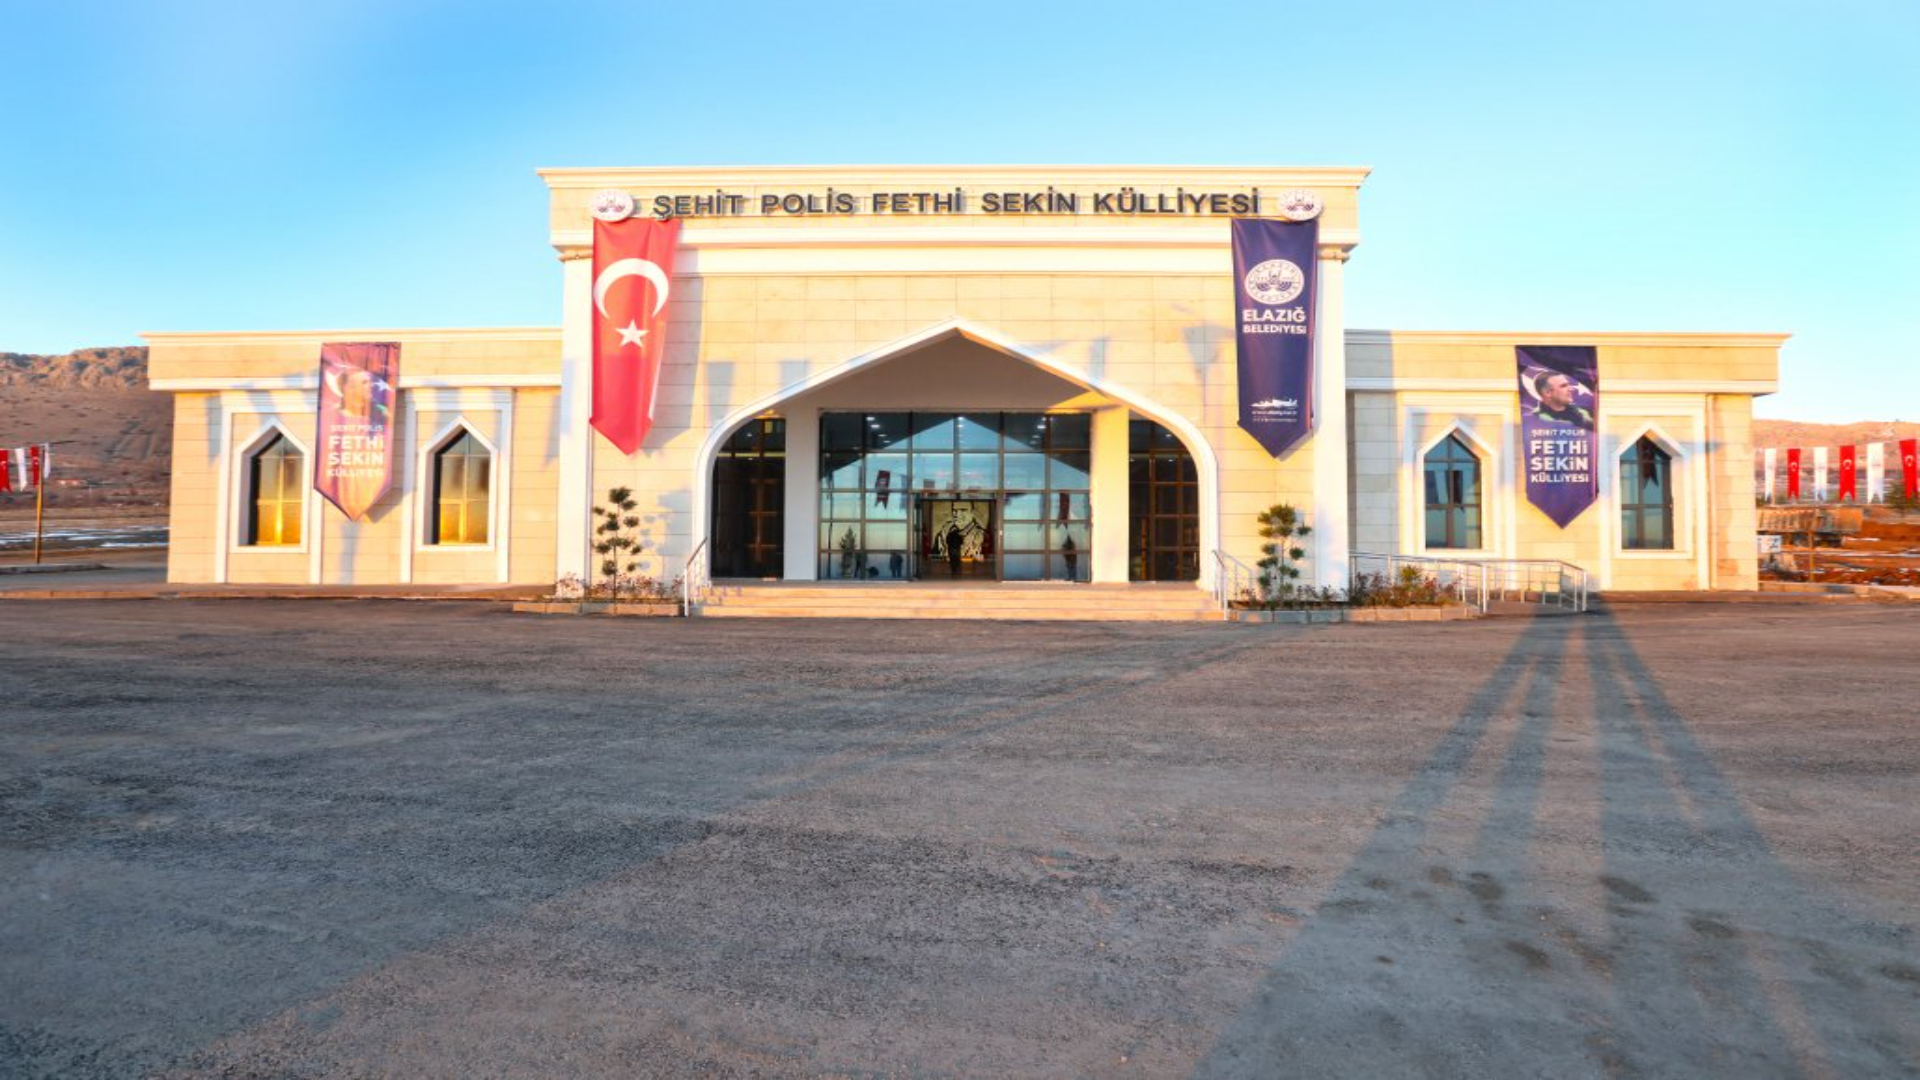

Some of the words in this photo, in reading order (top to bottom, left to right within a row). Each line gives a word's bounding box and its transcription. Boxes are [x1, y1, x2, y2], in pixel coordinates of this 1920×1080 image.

[653, 189, 743, 220] ŞEHİT
[761, 187, 854, 214] POLİS
[872, 187, 962, 214] FETHİ
[981, 186, 1076, 214] SEKİN
[1093, 186, 1259, 214] KÜLLİYESİ
[1242, 306, 1306, 323] ELAZIĞ
[1531, 440, 1588, 455] FETHİ
[1531, 456, 1589, 471] SEKİN
